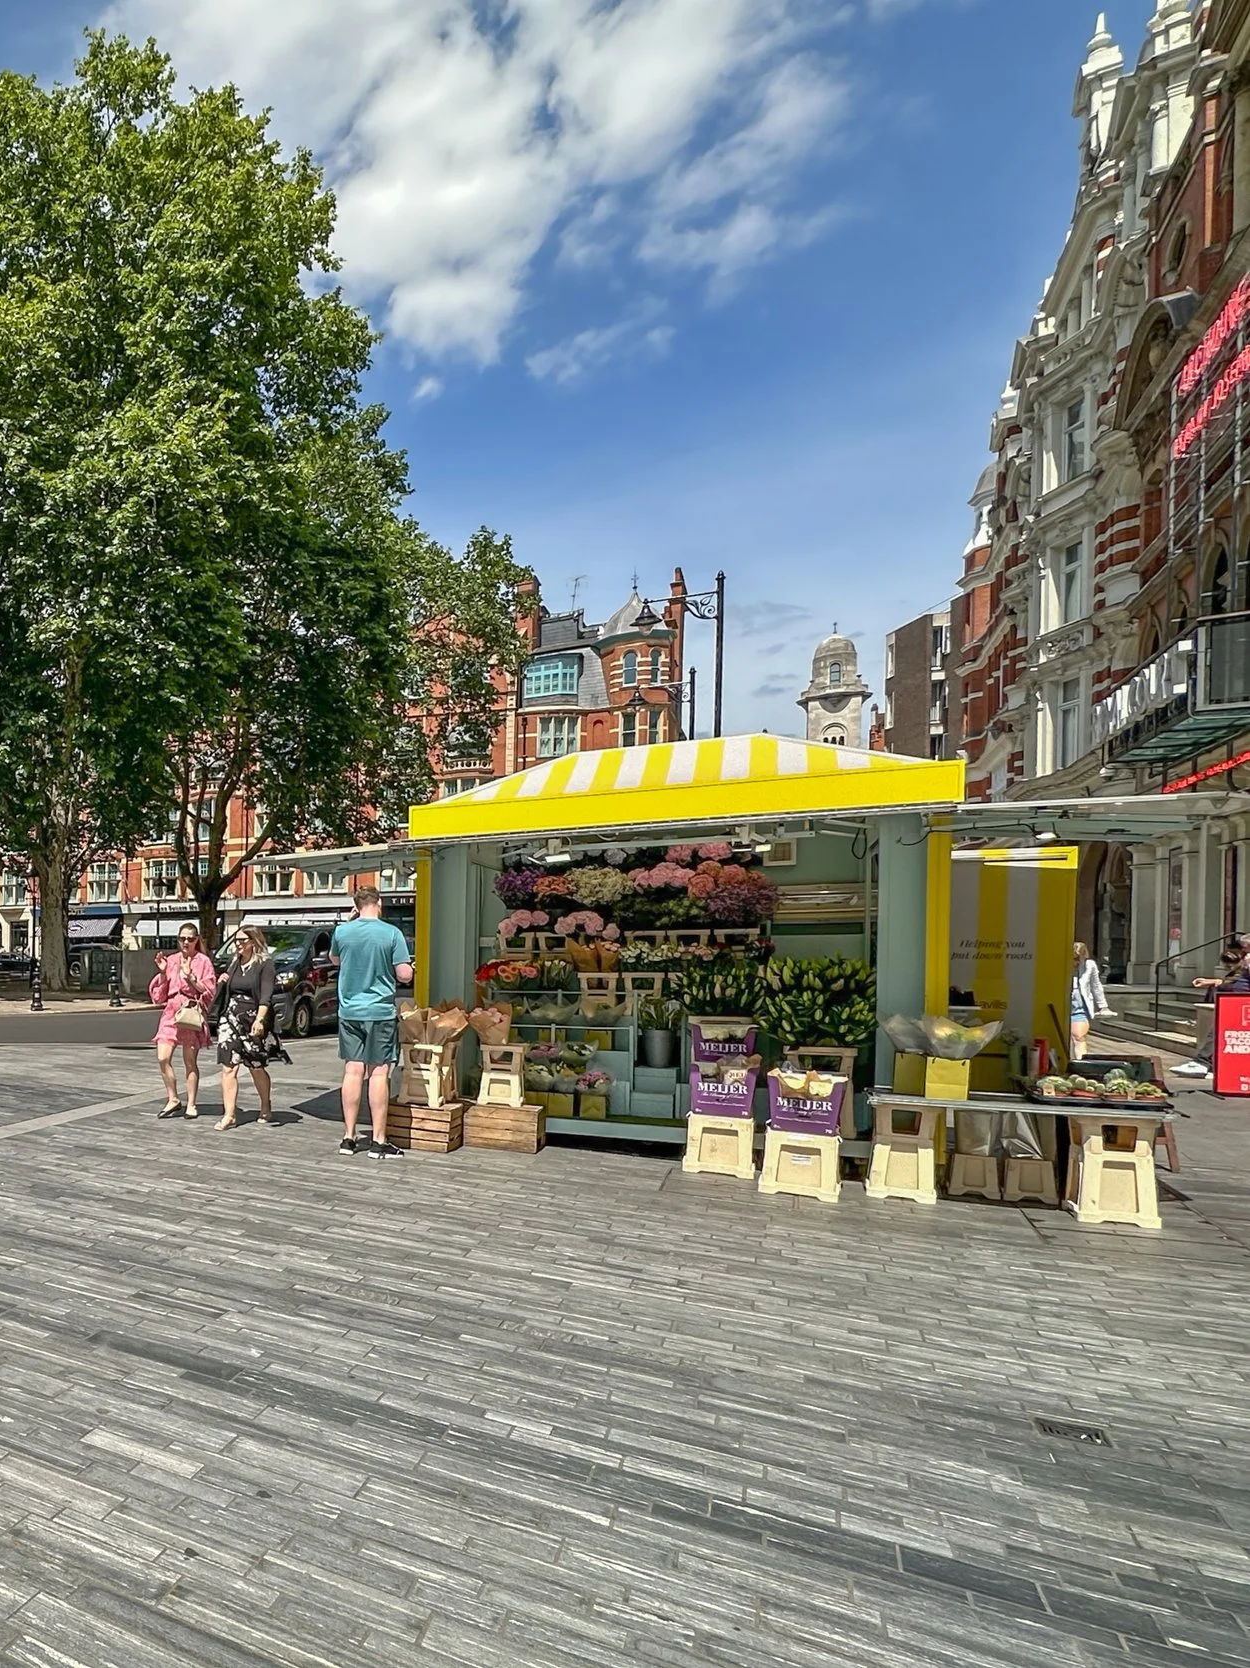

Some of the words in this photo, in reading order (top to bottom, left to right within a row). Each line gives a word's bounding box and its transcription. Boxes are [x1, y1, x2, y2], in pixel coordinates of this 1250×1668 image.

[959, 939, 1002, 950] Helping
[1003, 940, 1026, 950] you
[951, 951, 970, 961] put
[1005, 951, 1033, 960] roots
[699, 1042, 748, 1053] MEIJER
[697, 1082, 748, 1095] MEIJER
[776, 1096, 833, 1112] MEIJER
